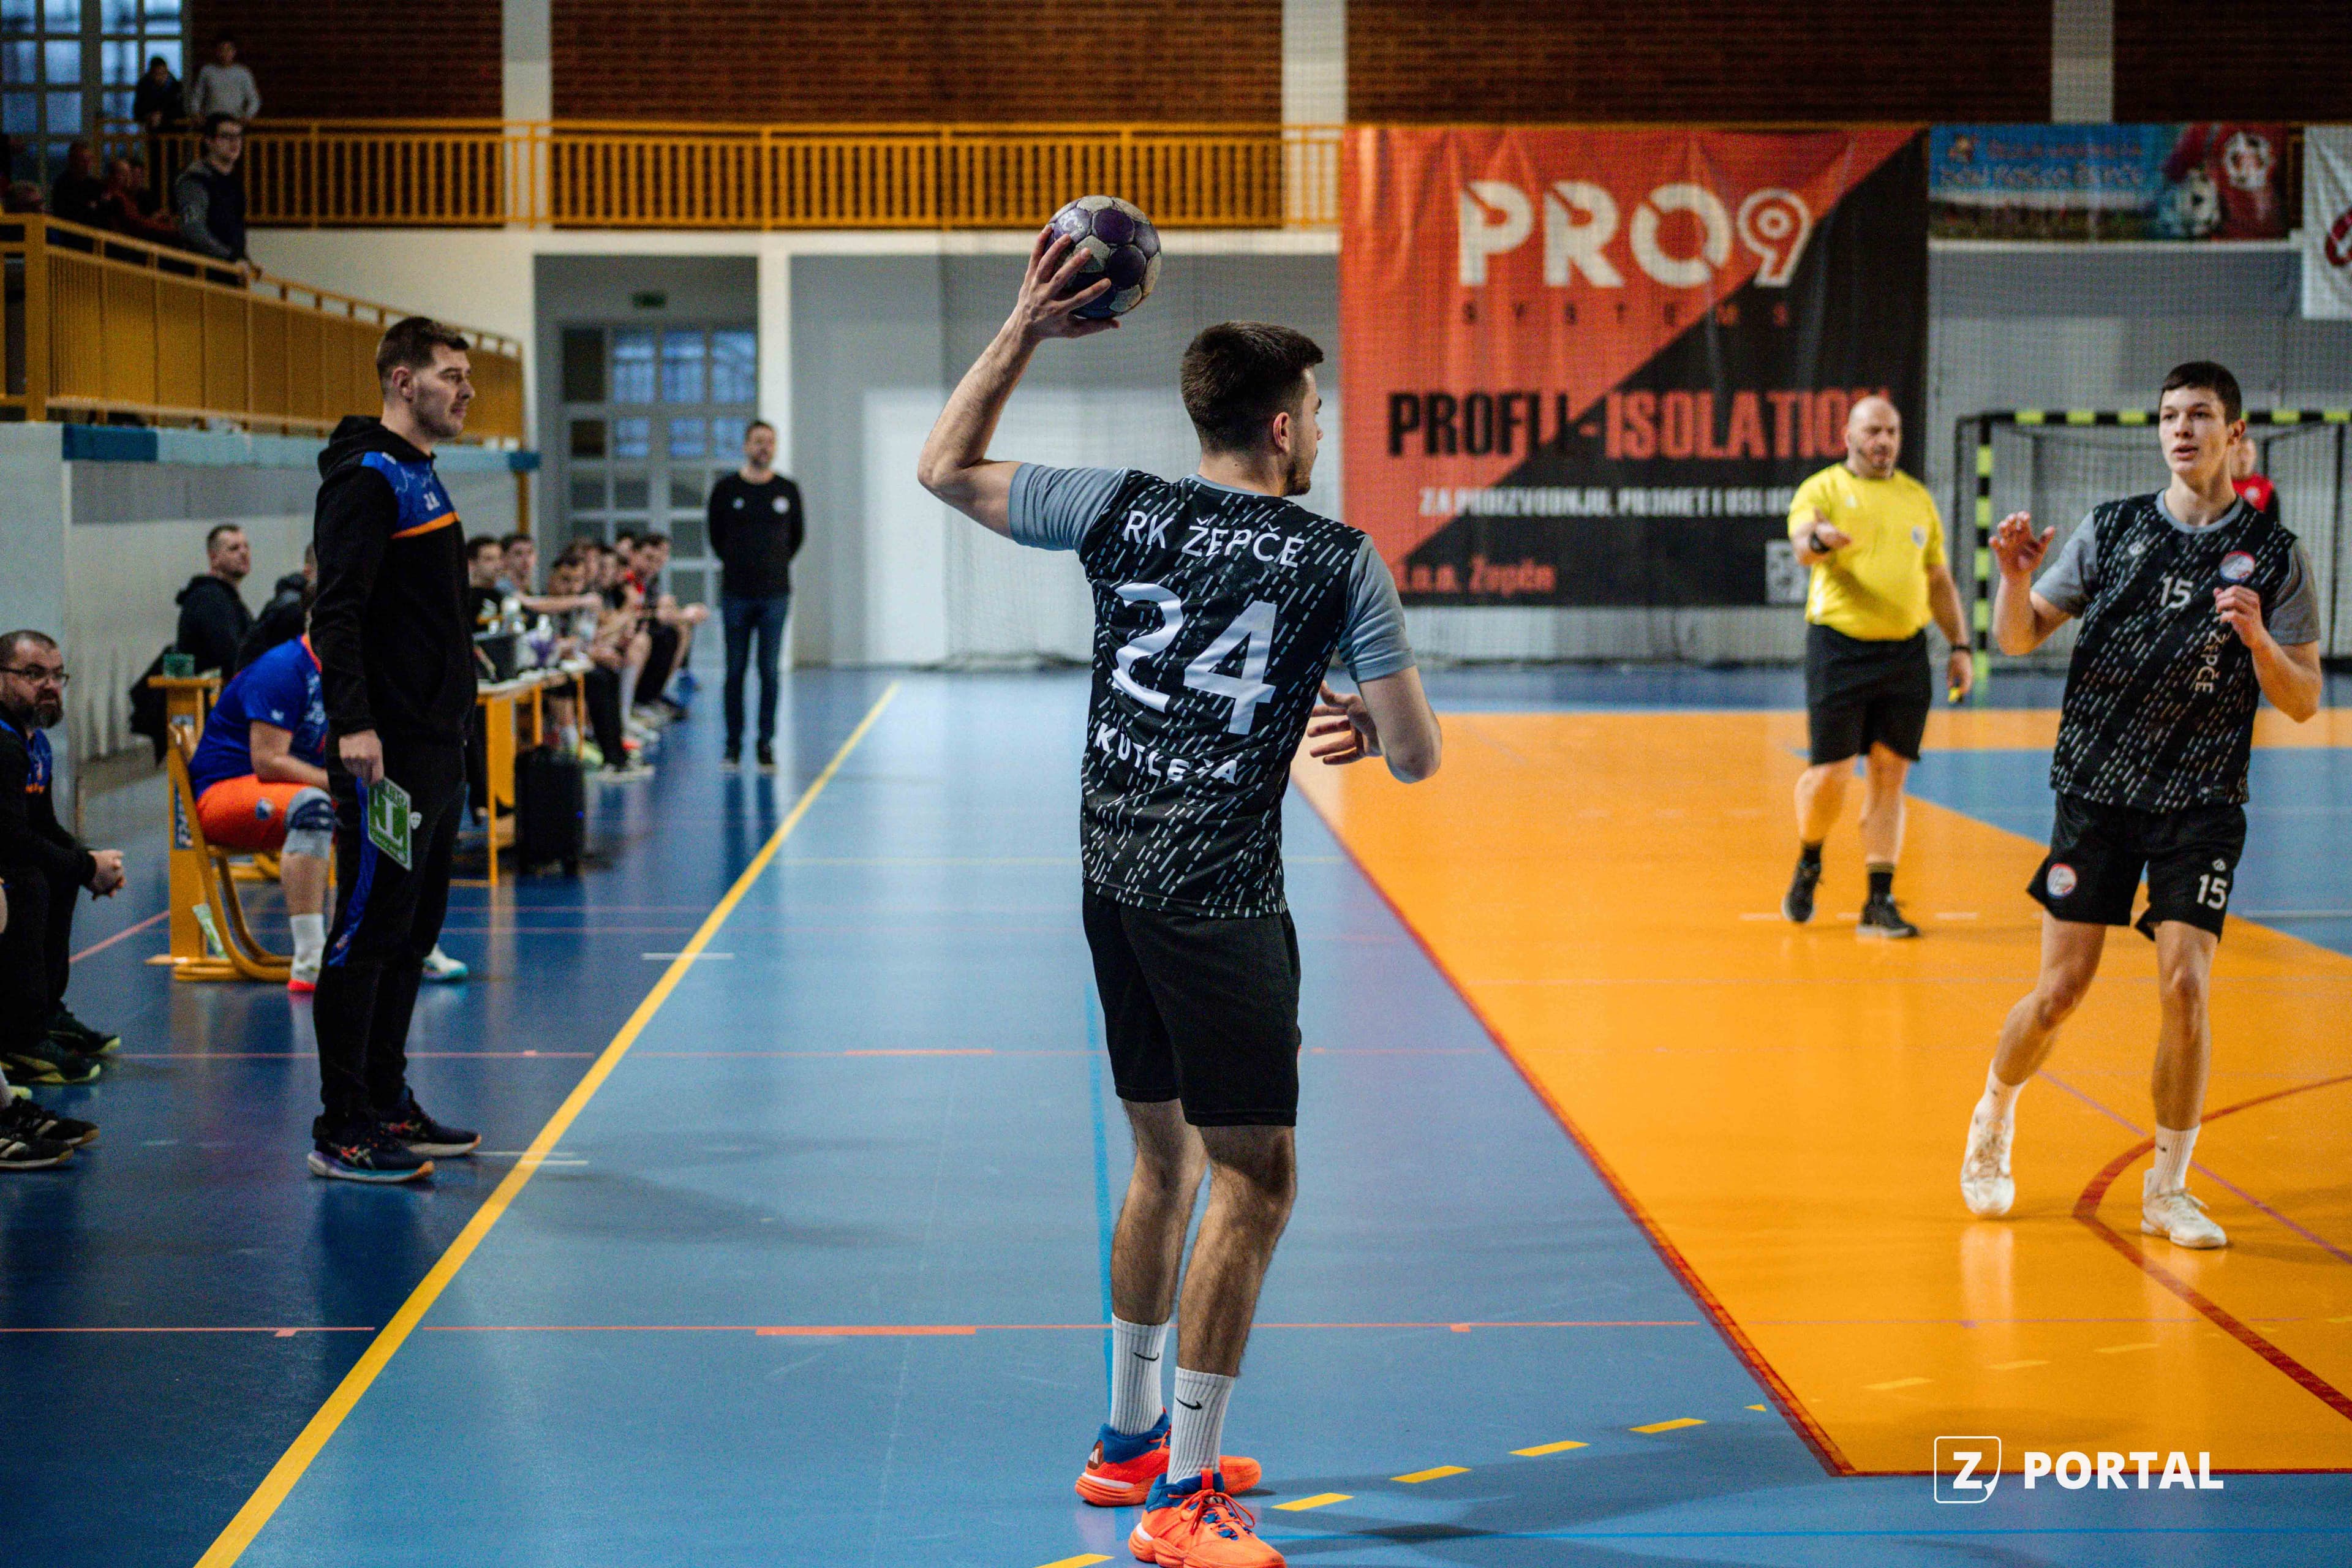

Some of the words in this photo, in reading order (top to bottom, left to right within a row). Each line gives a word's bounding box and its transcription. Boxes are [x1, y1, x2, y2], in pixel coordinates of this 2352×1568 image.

[1459, 180, 1812, 288] PRO9
[1388, 388, 1891, 459] PROFIL-ISOLATIO
[1123, 510, 1174, 549] RK
[1182, 518, 1305, 568] ŽEPČE
[2160, 576, 2194, 609] 15
[1111, 582, 1279, 736] 24
[2196, 873, 2228, 911] 15
